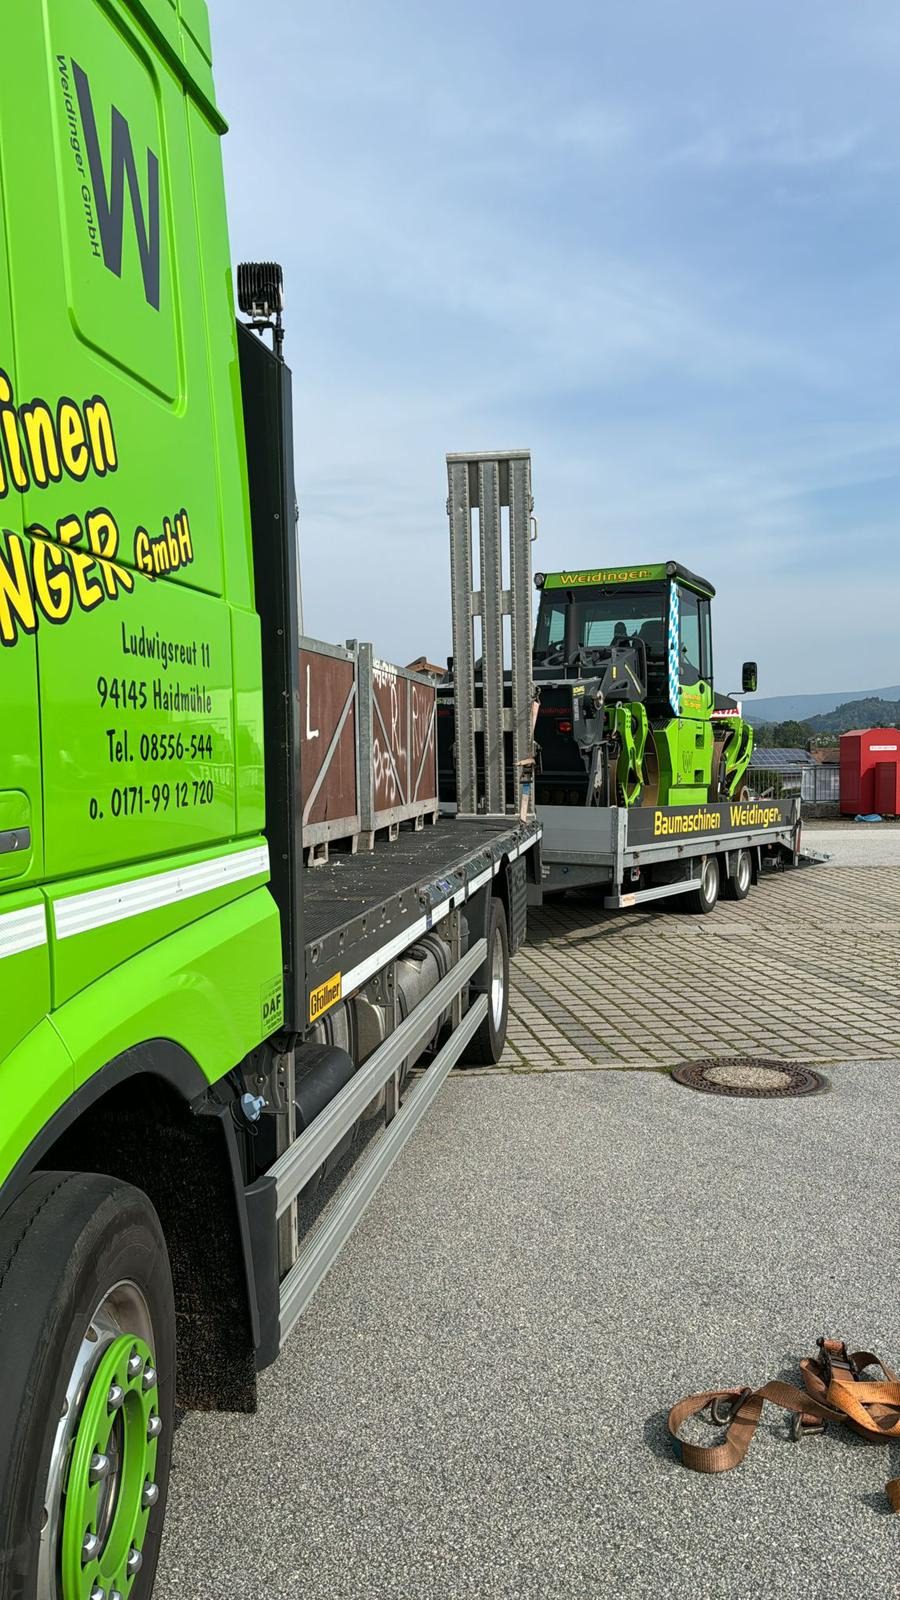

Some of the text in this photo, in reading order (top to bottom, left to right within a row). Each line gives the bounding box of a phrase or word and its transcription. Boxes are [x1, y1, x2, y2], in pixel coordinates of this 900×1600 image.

[56, 54, 101, 258] Weidinger GmbH
[70, 56, 160, 312] W
[0, 367, 118, 499] inen
[134, 508, 193, 582] GmbH
[559, 569, 648, 585] Weidinger
[121, 621, 210, 671] Ludwigsreut 11
[97, 676, 212, 714] 94145 Haidmühle
[106, 729, 213, 763] Tel. 08556-544
[89, 779, 214, 820] o. 0171-99 12 720
[654, 804, 779, 836] Baumaschinen Weidinger
[262, 993, 282, 1019] DAF
